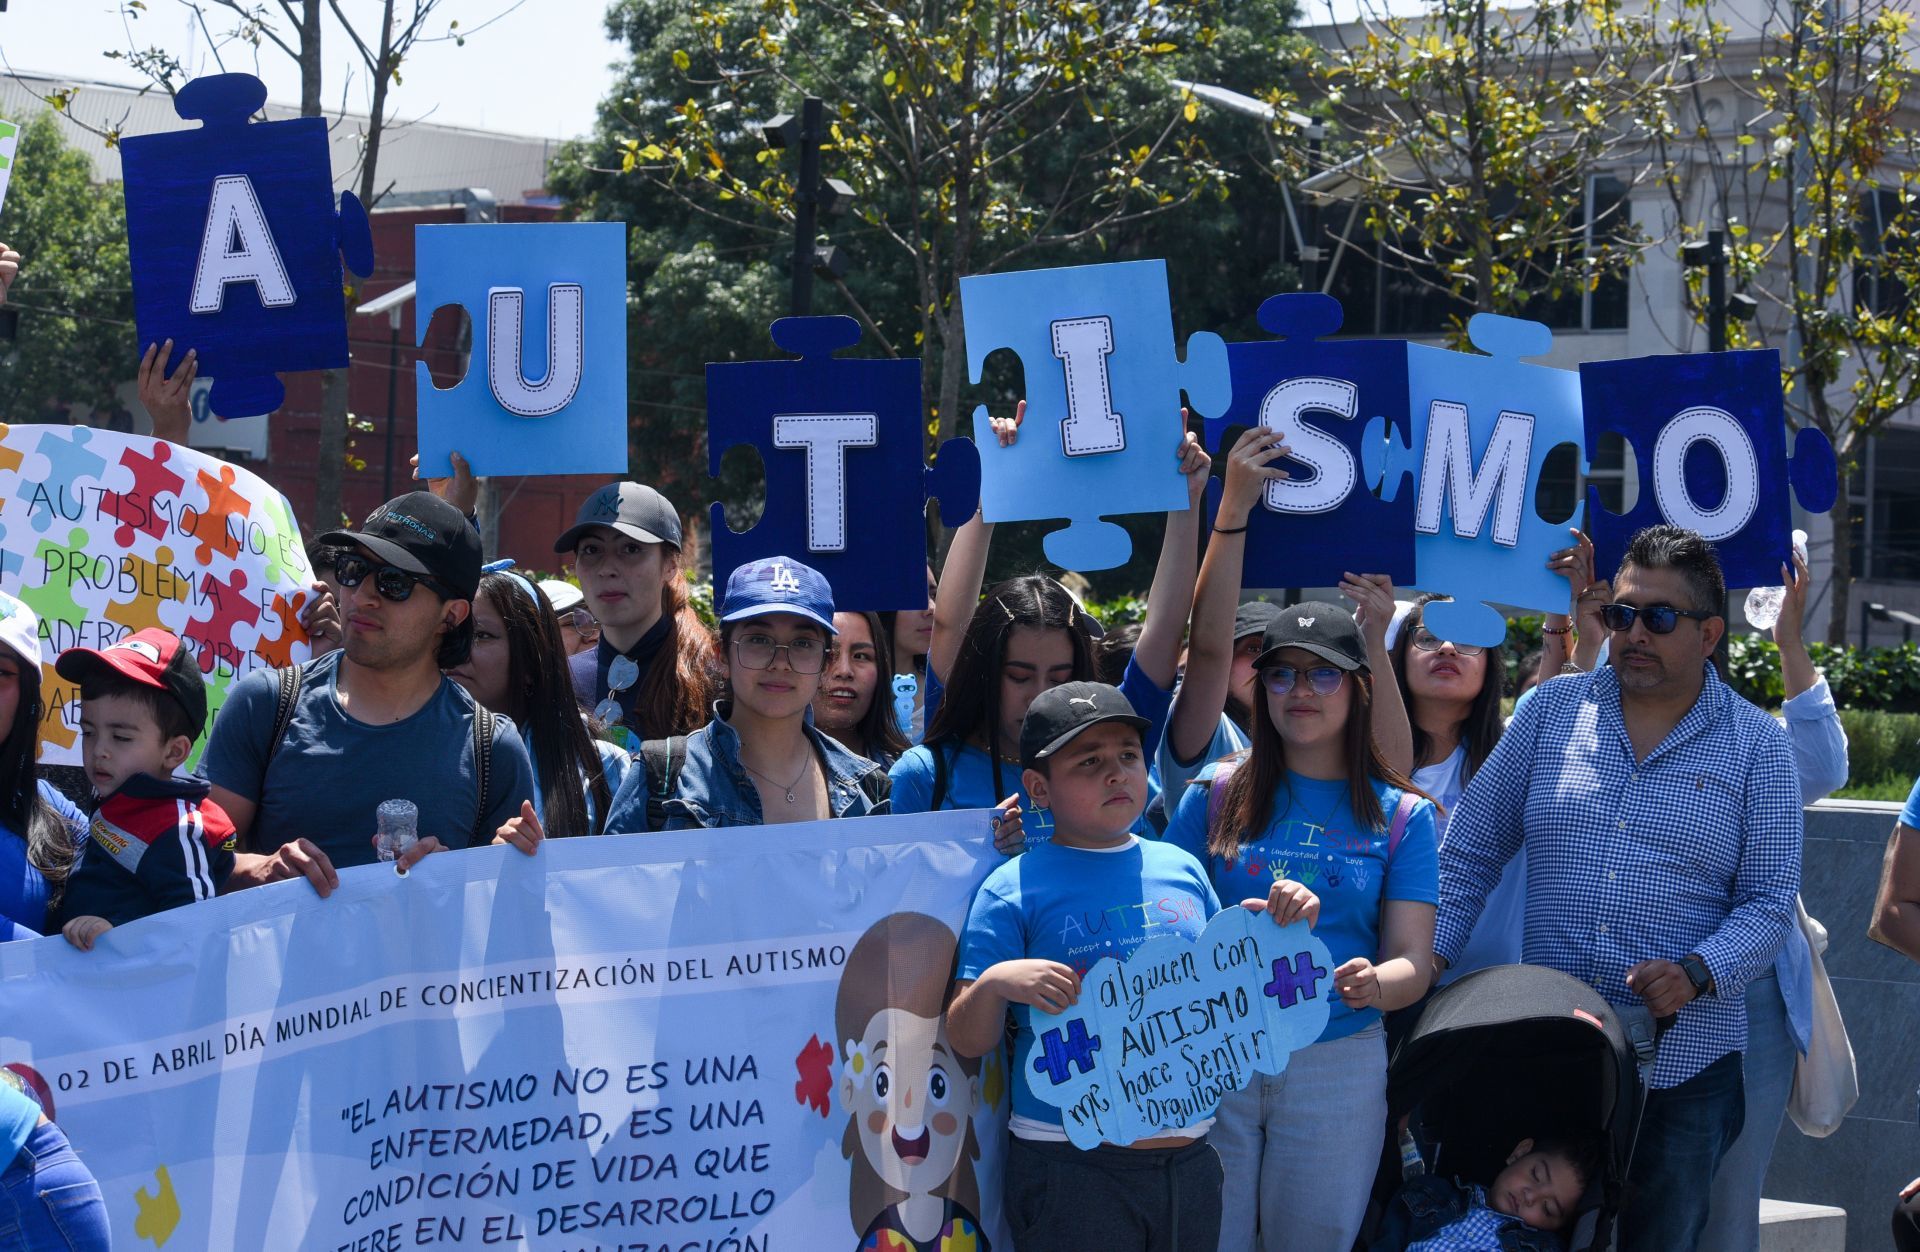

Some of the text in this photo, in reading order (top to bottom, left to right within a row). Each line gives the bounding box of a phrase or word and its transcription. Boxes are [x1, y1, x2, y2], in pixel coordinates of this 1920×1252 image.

[27, 482, 306, 573] AUTISMO NO ES
[387, 511, 437, 541] PETRONAS
[43, 549, 223, 611] PROBLEMA
[770, 563, 800, 595] LA
[1271, 847, 1364, 867] Understand Love
[1057, 896, 1201, 945] AUTISM
[1068, 942, 1101, 957] Accept
[58, 944, 846, 1092] 02 DE ABRIL DÍA MUNDIAL DE CONCIENTIZACIÓN DEL AUTISMO
[1121, 986, 1249, 1067] AUTISMO
[382, 1072, 537, 1116] AUTISMO
[552, 1066, 609, 1098] NO
[626, 1061, 668, 1094] ES
[684, 1053, 759, 1087] UNA
[1117, 1061, 1173, 1112] hace
[1180, 1029, 1266, 1087] Sentir
[370, 1099, 764, 1171] ENFERMEDAD, ES UNA
[343, 1142, 770, 1226] CONDICIÓN DE VIDA QUE
[415, 1215, 465, 1246] EN
[482, 1214, 524, 1245] EL
[536, 1187, 776, 1237] DESARROLLO
